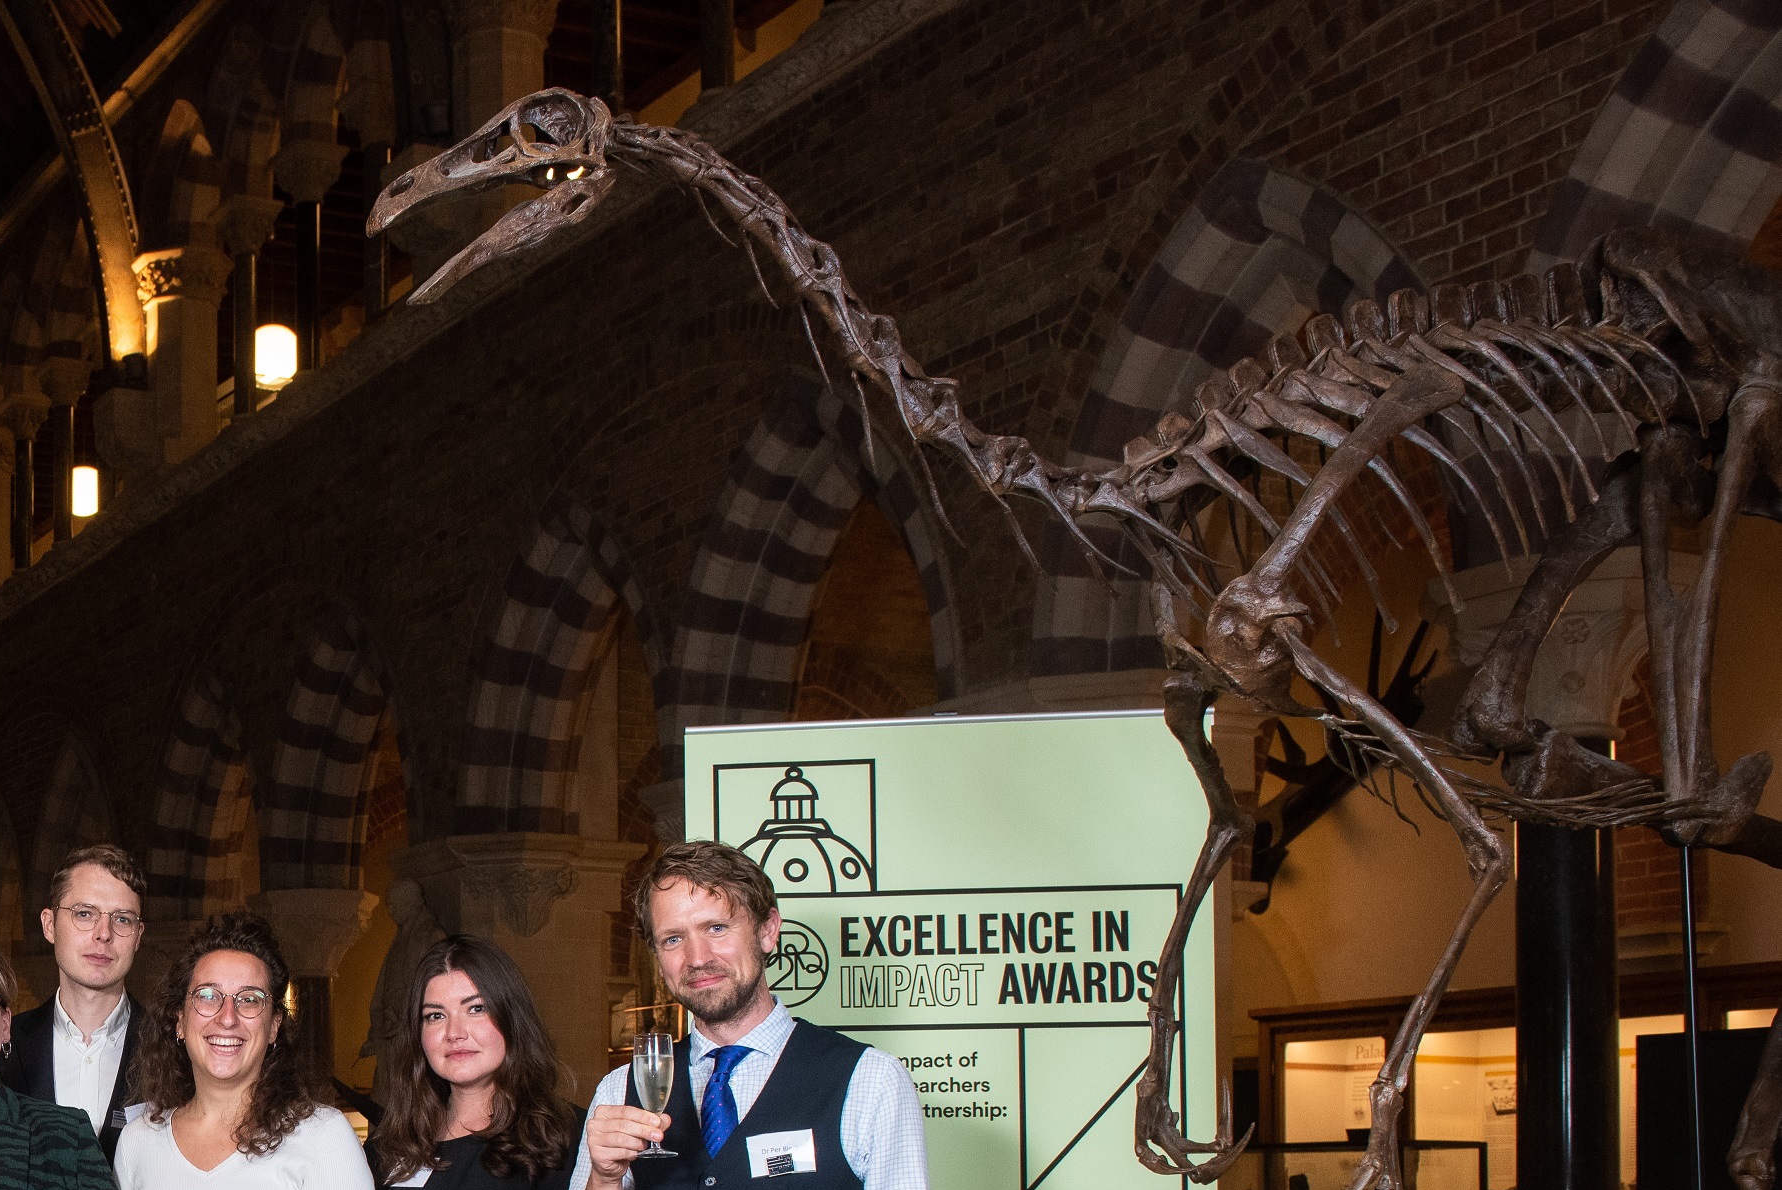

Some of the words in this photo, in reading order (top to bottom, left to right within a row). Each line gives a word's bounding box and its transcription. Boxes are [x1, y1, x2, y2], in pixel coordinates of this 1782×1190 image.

[840, 911, 1075, 958] EXCELLENCE
[1092, 910, 1130, 952] IN
[841, 963, 984, 1008] IMPACT
[998, 961, 1158, 1005] AWARDS
[896, 1053, 952, 1071] mpact
[959, 1051, 978, 1068] of
[923, 1102, 1007, 1121] tnership:
